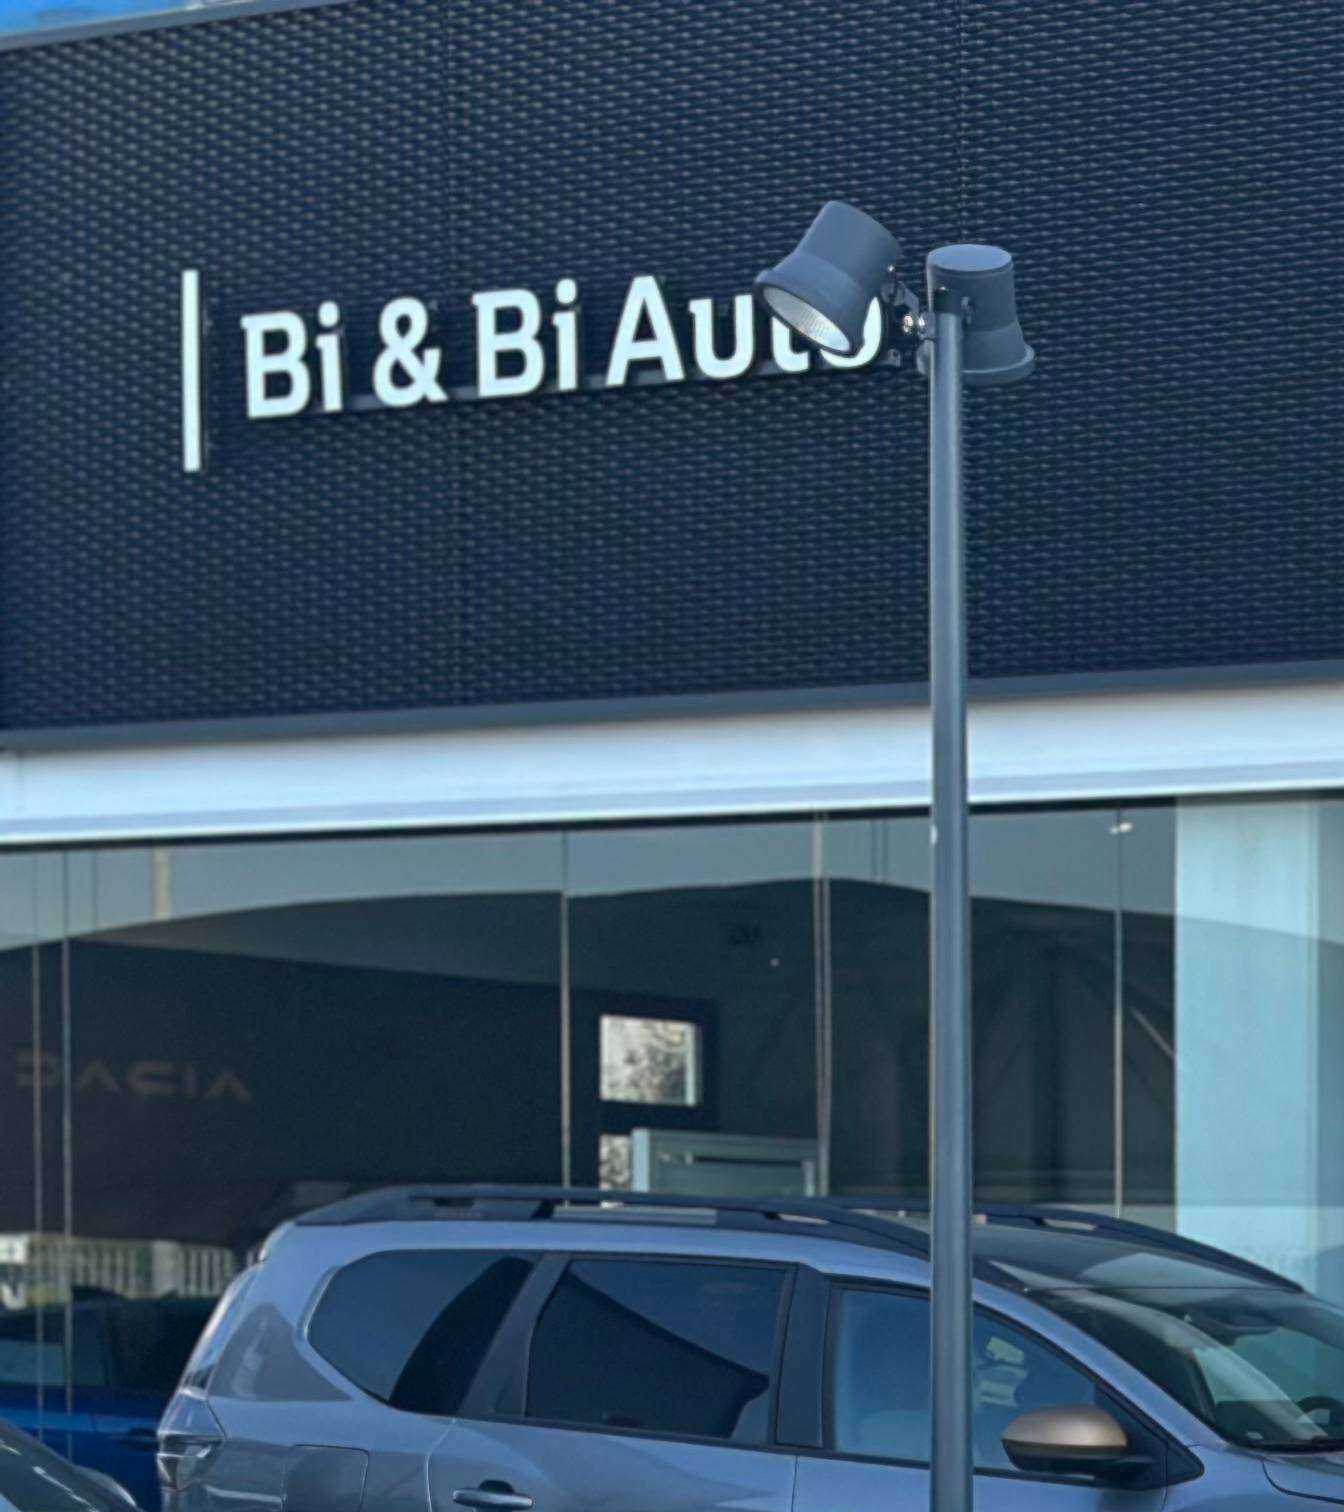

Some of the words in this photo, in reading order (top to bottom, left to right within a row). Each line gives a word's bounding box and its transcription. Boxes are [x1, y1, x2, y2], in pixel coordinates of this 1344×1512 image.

[241, 300, 342, 418] Bi
[372, 297, 448, 406] &
[472, 279, 578, 398] Bi
